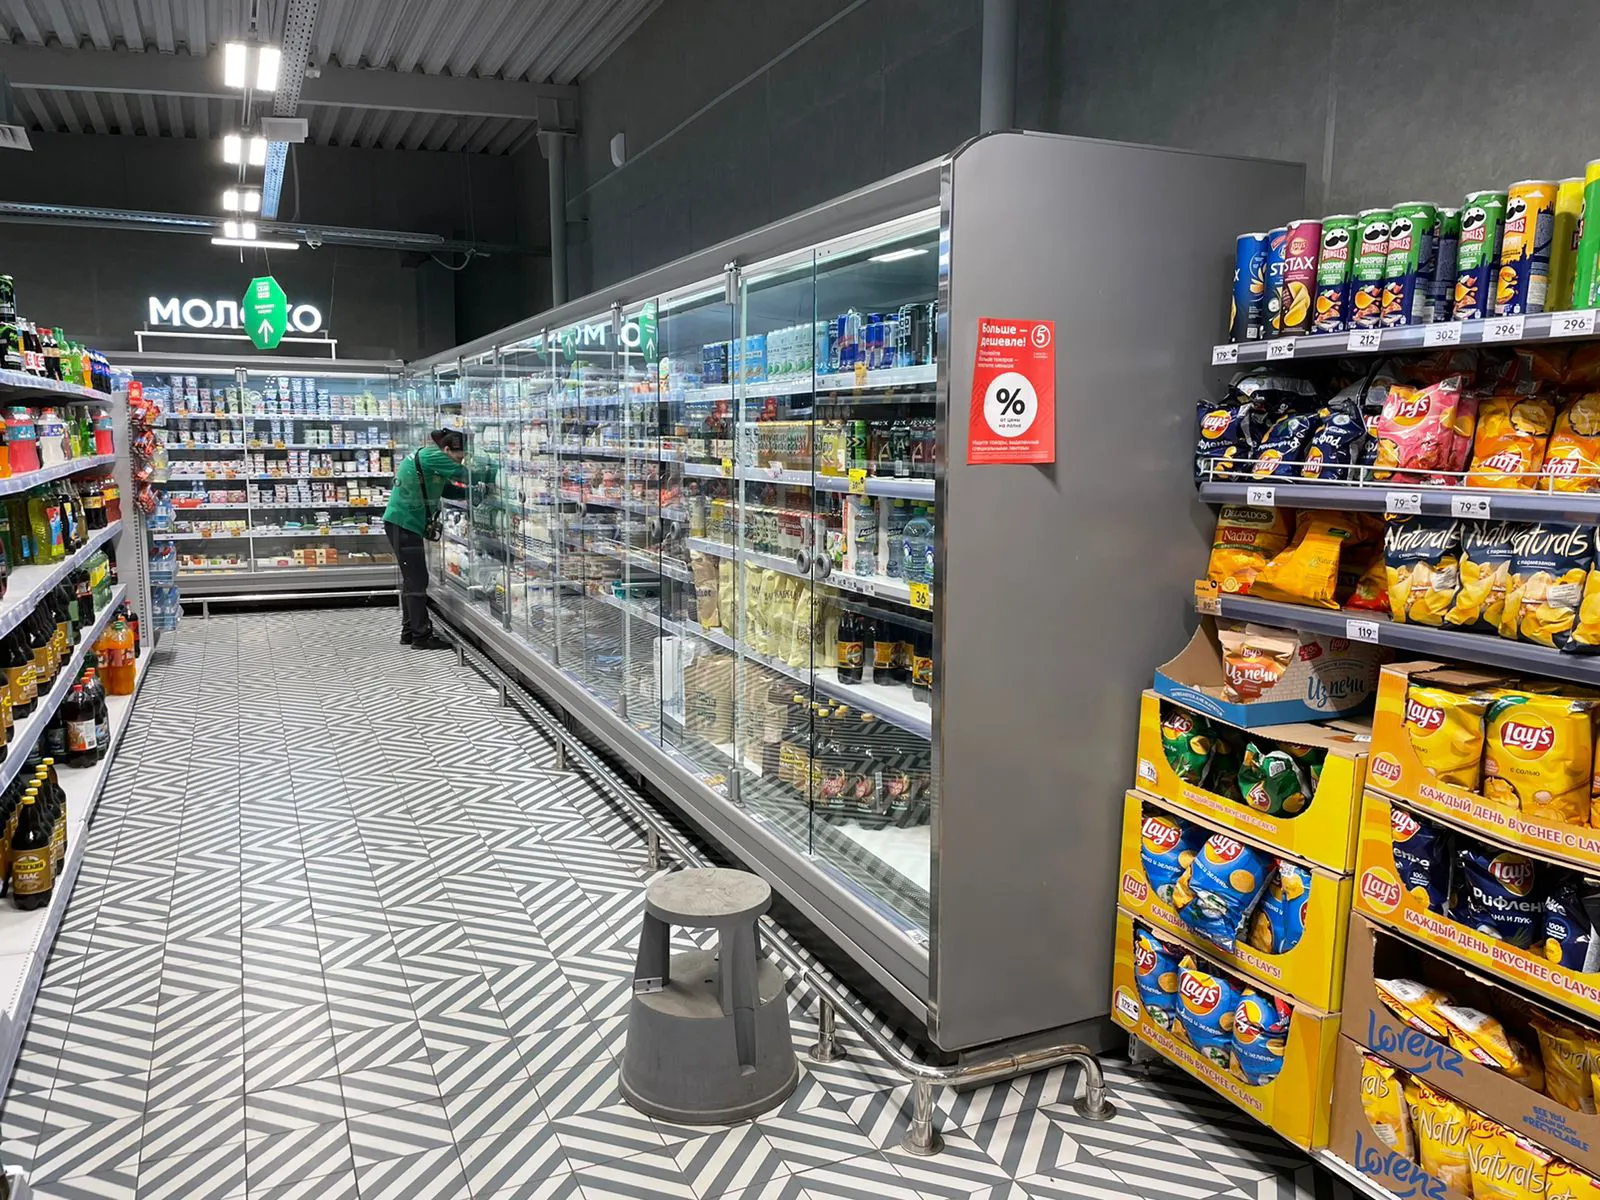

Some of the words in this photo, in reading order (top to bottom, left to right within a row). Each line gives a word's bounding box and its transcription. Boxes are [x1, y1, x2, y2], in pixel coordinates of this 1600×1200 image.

[1285, 256, 1315, 272] STAX
[148, 296, 322, 333] МОЛО
[1564, 319, 1586, 330] 296
[982, 323, 1017, 335] Больше
[1360, 335, 1375, 345] 212
[1436, 330, 1454, 340] 302
[1495, 325, 1515, 336] 296
[980, 336, 1027, 348] дешевле!
[1271, 345, 1282, 354] 179
[1216, 351, 1228, 360] 179
[1253, 491, 1261, 500] 79
[1394, 498, 1405, 508] 79
[1460, 502, 1471, 511] 79
[1223, 508, 1268, 521] DELICADOS
[1223, 529, 1255, 542] Nachos
[1384, 520, 1461, 551] Naturals
[916, 591, 926, 604] 36
[1358, 627, 1373, 637] 119
[1226, 663, 1243, 685] Из
[1246, 669, 1279, 684] печи
[1308, 676, 1327, 708] Из
[1329, 676, 1364, 698] печи
[1406, 699, 1442, 728] Lay's
[1503, 722, 1551, 750] Lay's
[1372, 758, 1400, 781] Lay's
[1516, 768, 1540, 777] солью
[1419, 785, 1471, 813] КАЖДЫЙ
[1473, 806, 1505, 825] ДЕНЬ
[1564, 834, 1576, 847] С
[1143, 816, 1181, 845] Lay's
[1490, 862, 1532, 886] Lay's
[1124, 874, 1147, 901] Lay's
[1362, 873, 1400, 902] Lay's
[1404, 909, 1456, 938] КАЖДЫЙ
[1458, 933, 1489, 954] ДЕНЬ
[1491, 947, 1548, 980] ВКУСНЕЕ
[1550, 972, 1562, 985] С
[1564, 979, 1600, 1002] LAY'S!
[1255, 955, 1281, 979] LAY'S!
[1181, 973, 1219, 1006] Lay's
[1368, 1009, 1465, 1077] Lorenz
[1141, 1023, 1174, 1052] КАЖДЫЙ
[1174, 1044, 1195, 1066] ДЕНЬ
[1194, 1060, 1231, 1092] ВКУСНЕЕ
[1239, 1089, 1263, 1112] LAY'S!
[1533, 1106, 1547, 1117] SEE
[1550, 1112, 1566, 1124] YOU
[1522, 1115, 1590, 1153] #RECYCLABLE
[1354, 1130, 1448, 1200] Lorenz
[1467, 1142, 1545, 1193] Naturals
